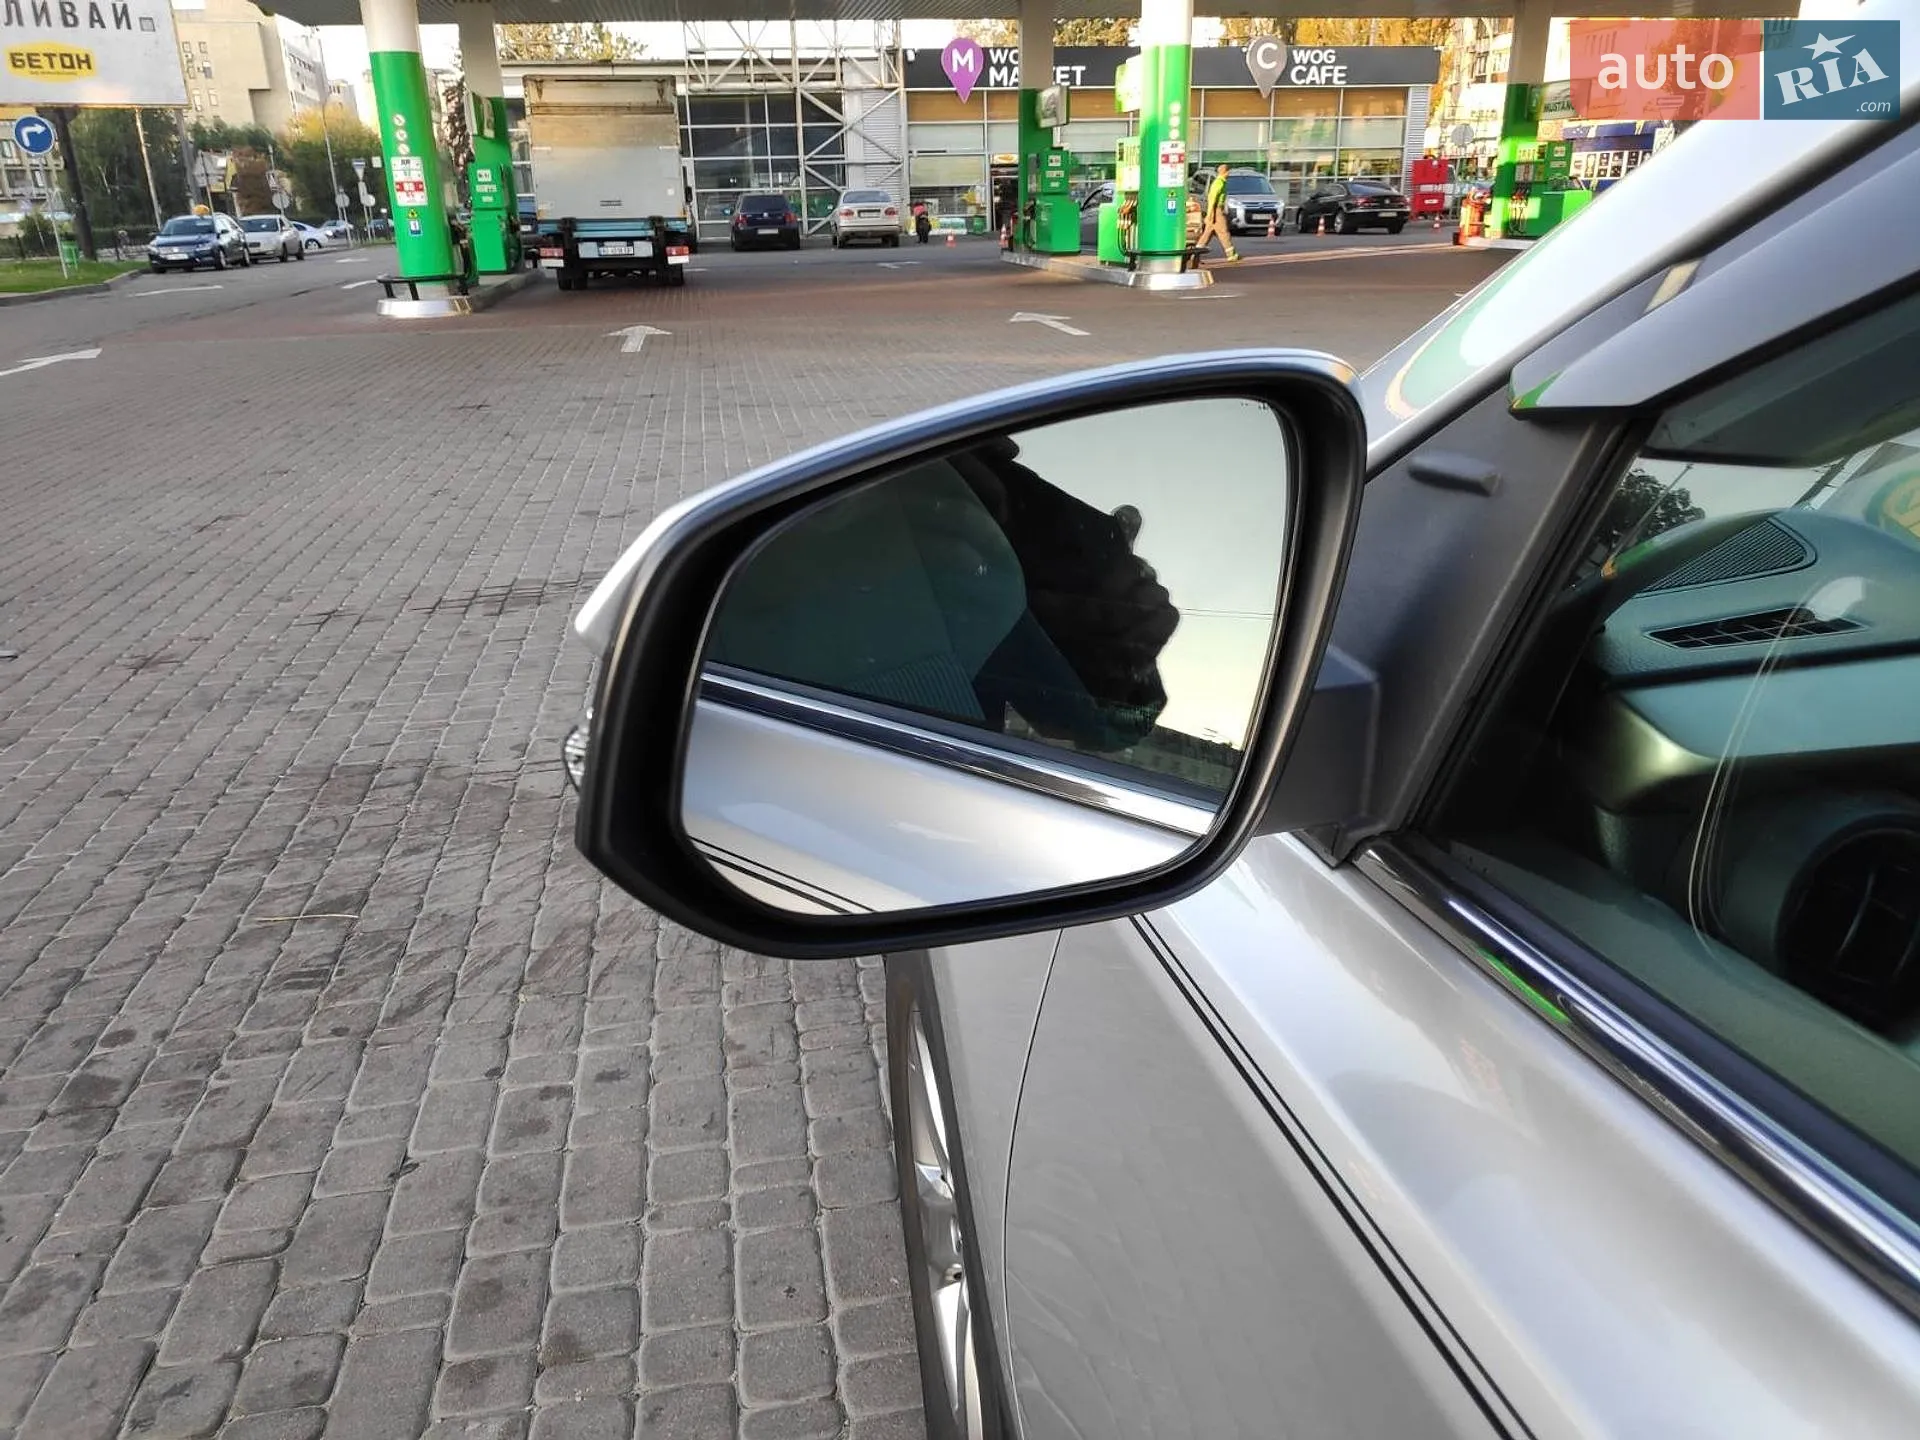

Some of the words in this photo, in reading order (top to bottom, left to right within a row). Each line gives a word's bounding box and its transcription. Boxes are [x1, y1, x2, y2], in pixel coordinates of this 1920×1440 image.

[10, 52, 92, 70] БЕТОН
[951, 48, 975, 73] M
[988, 48, 1019, 64] WO
[1256, 42, 1278, 70] C
[1292, 49, 1336, 64] WOG
[988, 65, 1086, 87] MAET
[1290, 65, 1348, 85] CAFE
